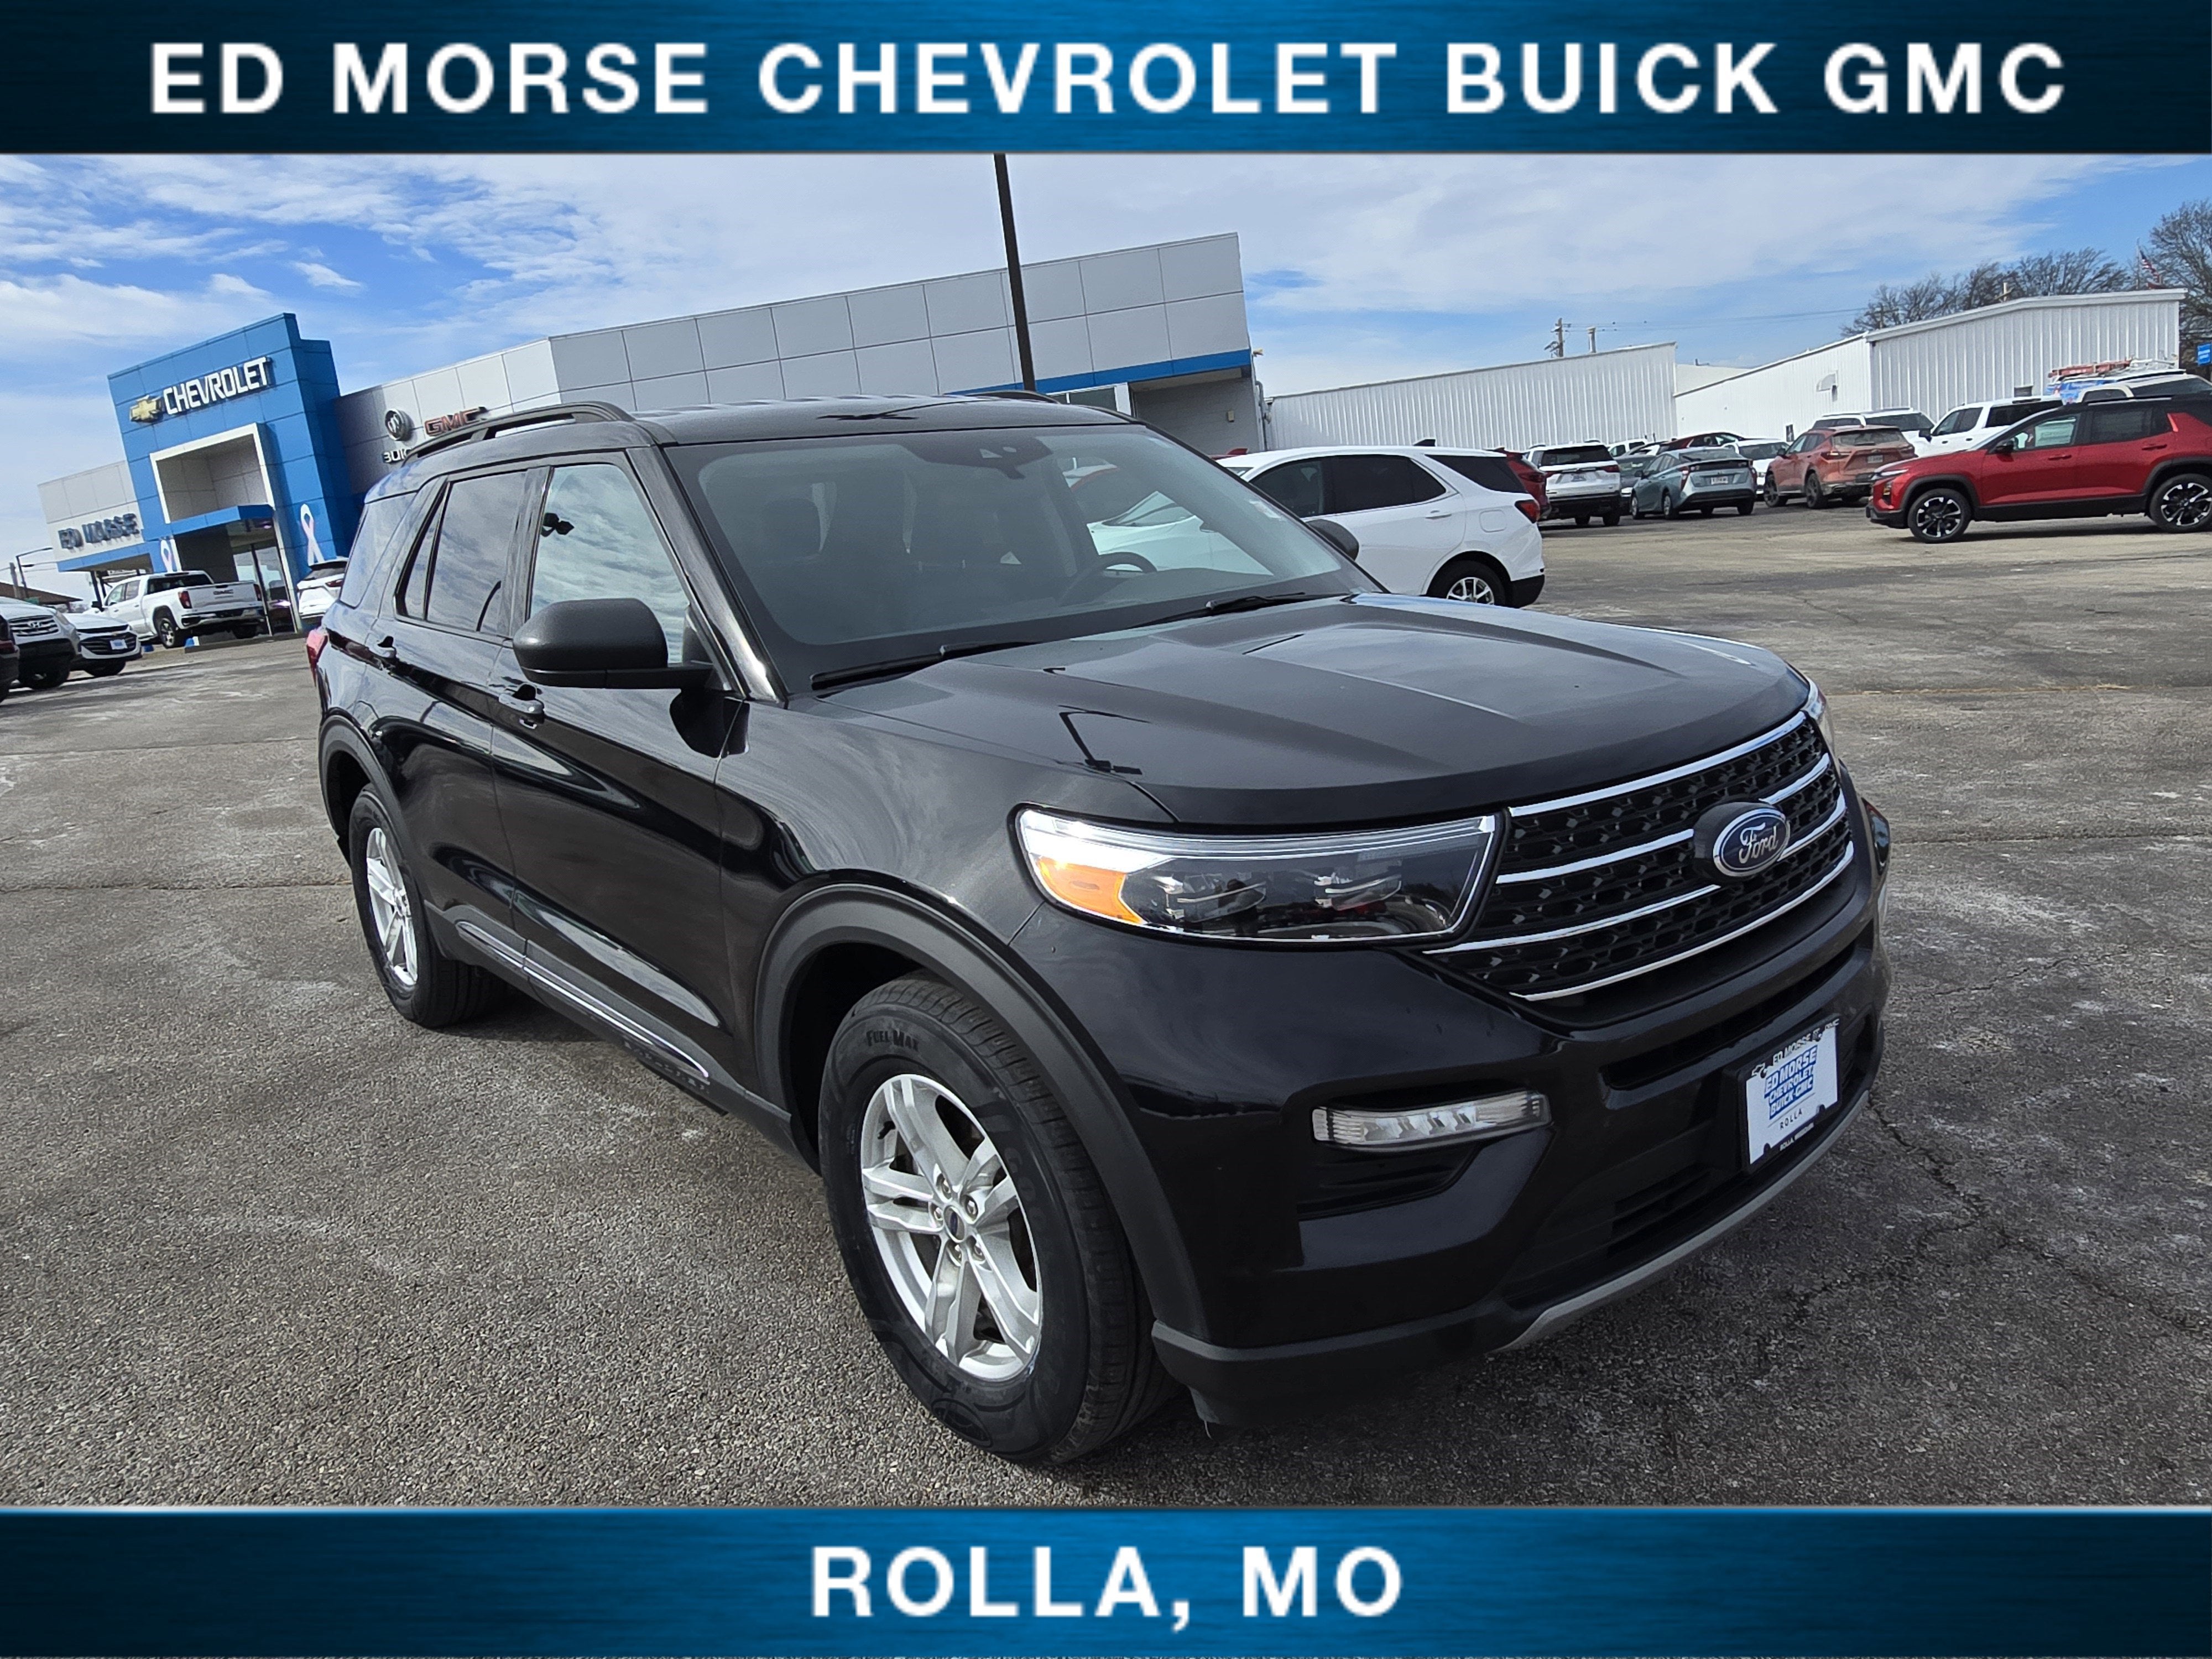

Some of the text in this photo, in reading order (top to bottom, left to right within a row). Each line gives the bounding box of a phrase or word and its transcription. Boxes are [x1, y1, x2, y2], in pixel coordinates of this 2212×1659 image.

[163, 357, 268, 415] CHEVROLET
[424, 407, 482, 436] GMC
[383, 448, 413, 463] BUI
[1739, 822, 1779, 864] Ford
[866, 1029, 919, 1051] FUEL MAX
[1765, 1046, 1817, 1094] ED MORSE
[1769, 1065, 1813, 1104] CHEVROLET
[1780, 1107, 1802, 1130] ROLLA
